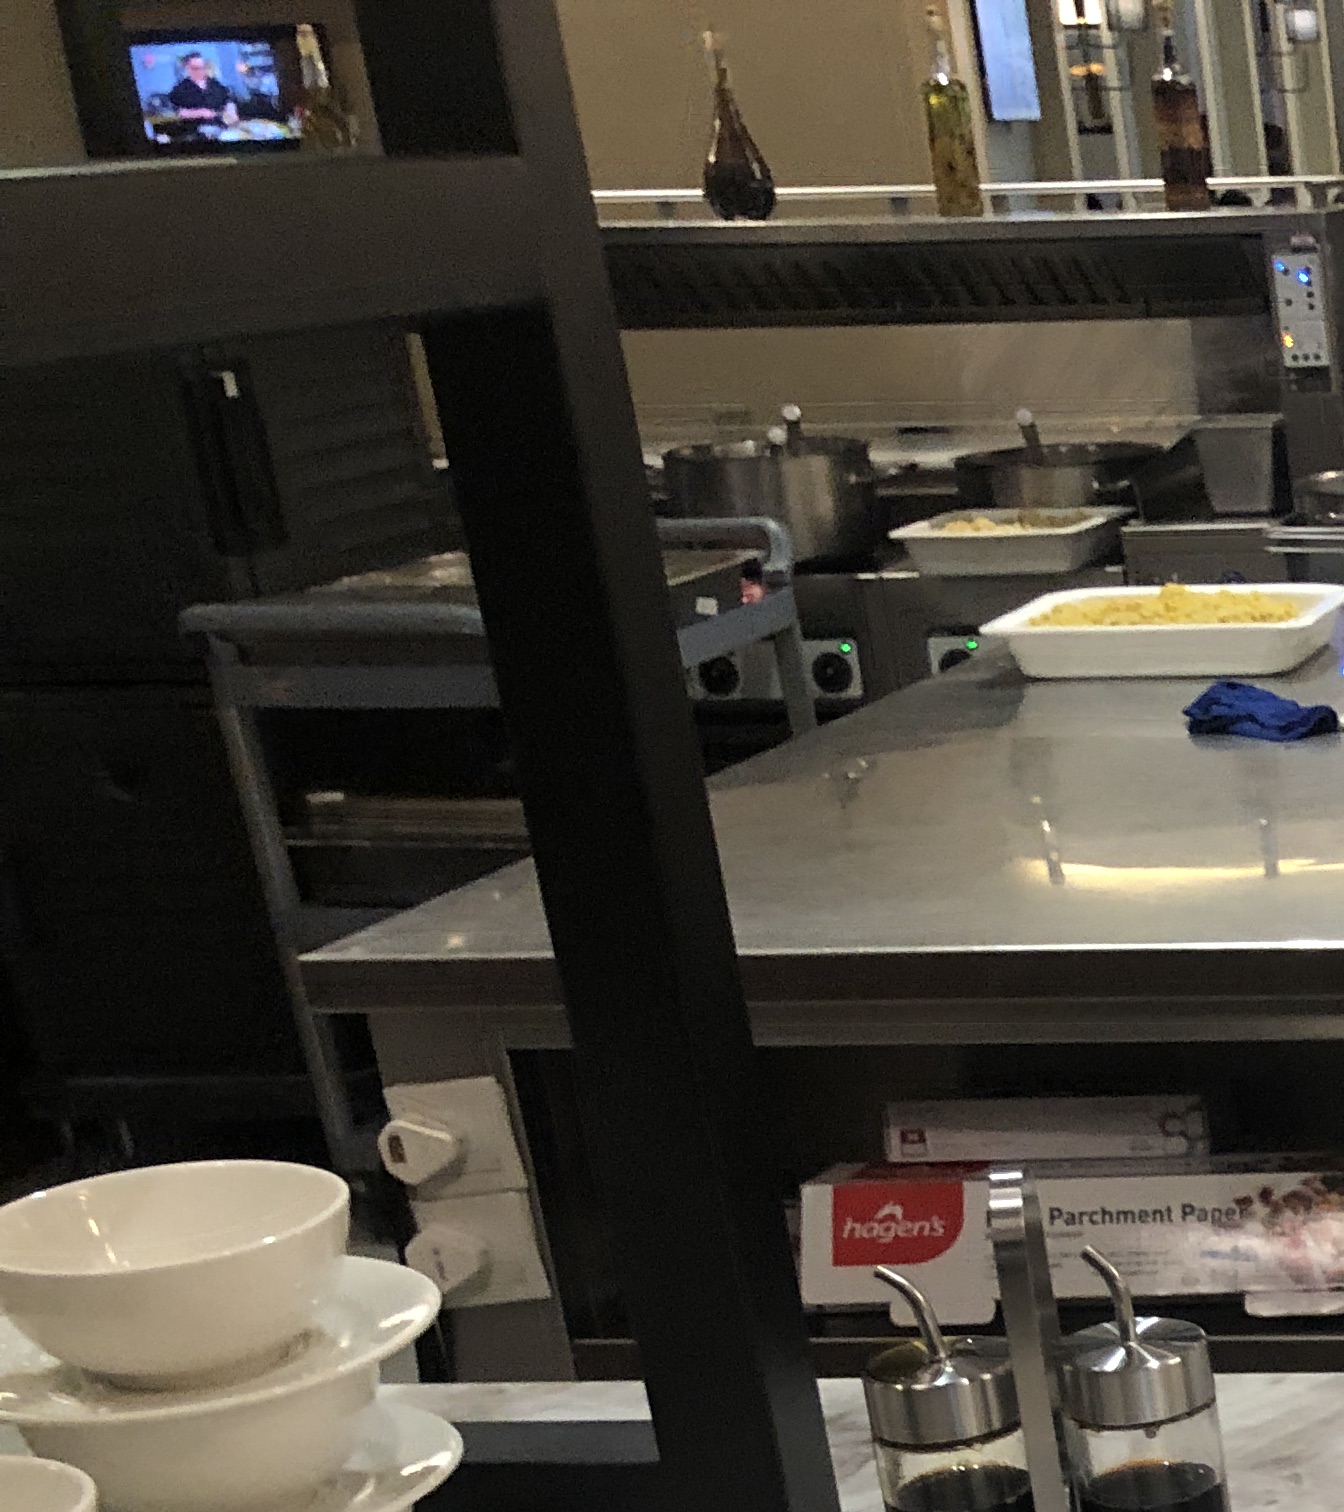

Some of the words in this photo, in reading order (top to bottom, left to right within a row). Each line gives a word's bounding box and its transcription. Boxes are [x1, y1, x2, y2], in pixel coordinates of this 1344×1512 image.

[842, 1214, 946, 1243] hagen's
[1048, 1205, 1174, 1227] Parchment
[1180, 1202, 1248, 1228] Paper
